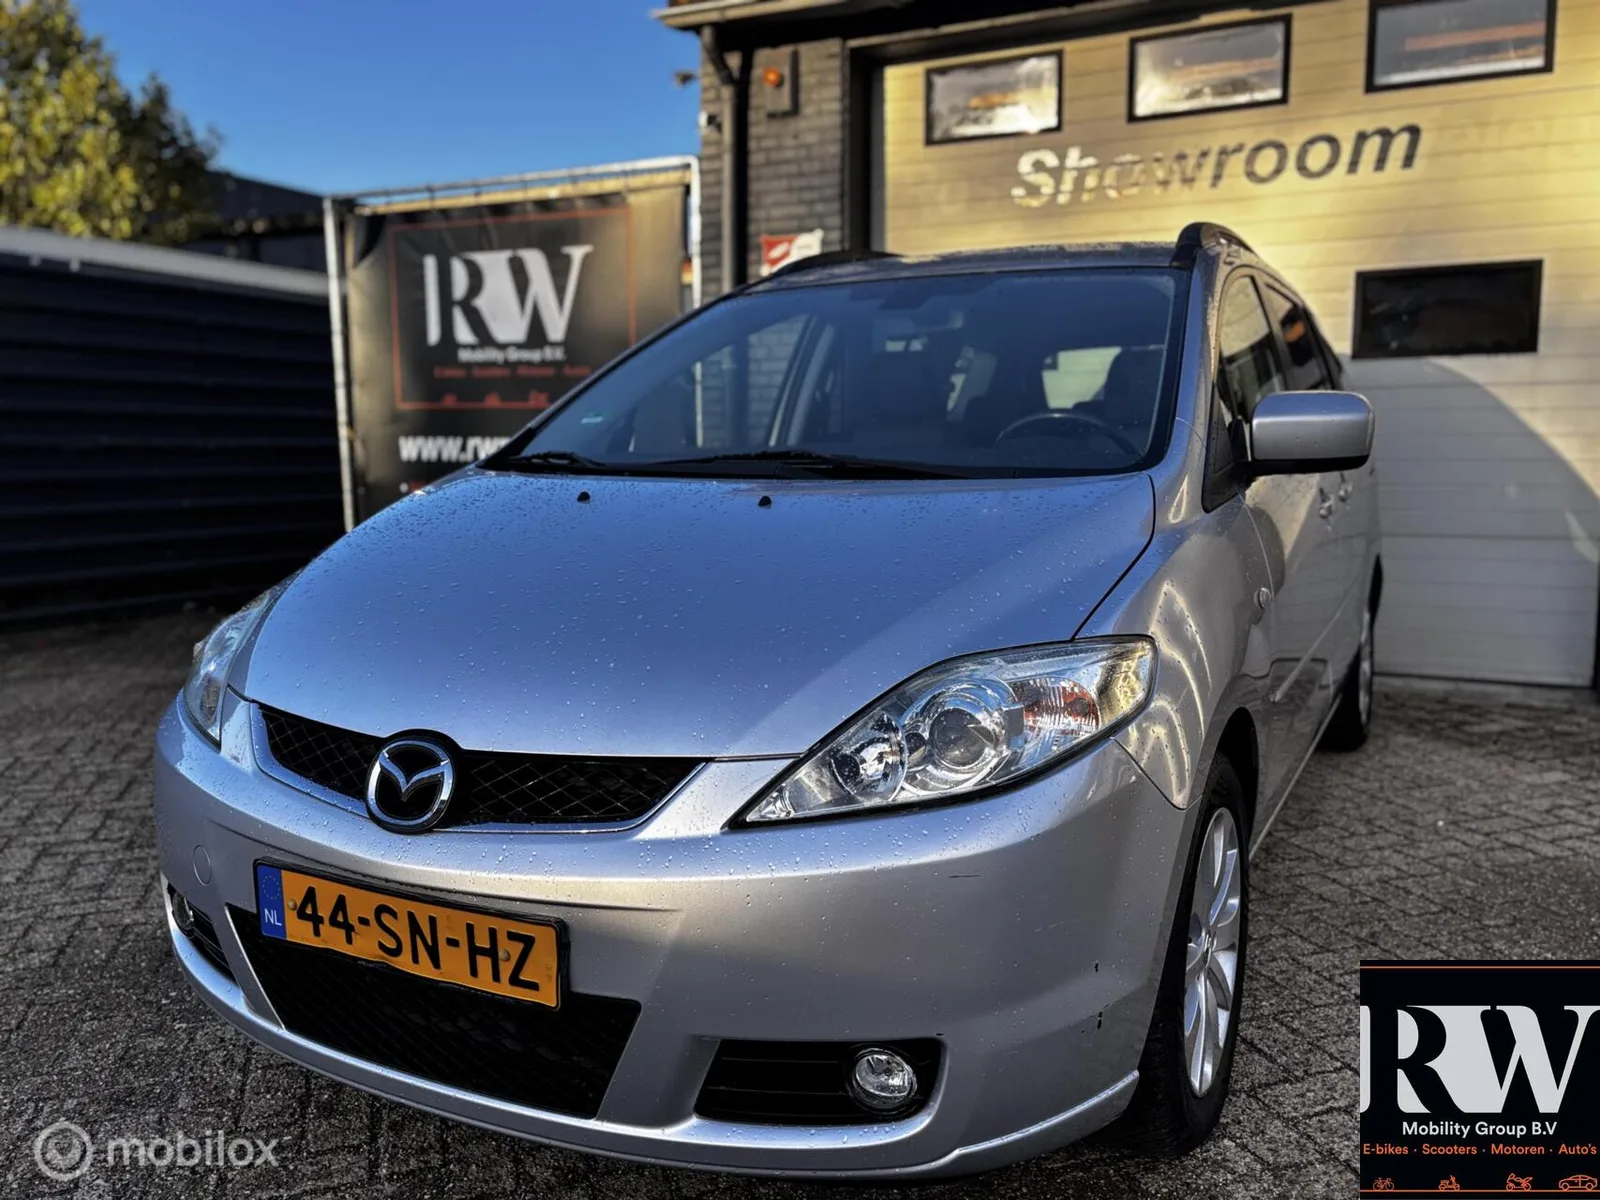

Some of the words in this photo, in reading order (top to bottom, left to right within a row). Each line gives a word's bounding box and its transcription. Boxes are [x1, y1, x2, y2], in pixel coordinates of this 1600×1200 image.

[1010, 123, 1422, 208] Showroom
[457, 346, 504, 364] Mobility
[506, 346, 541, 363] Group
[264, 911, 283, 926] NL
[296, 886, 540, 992] 44-SN-HZ
